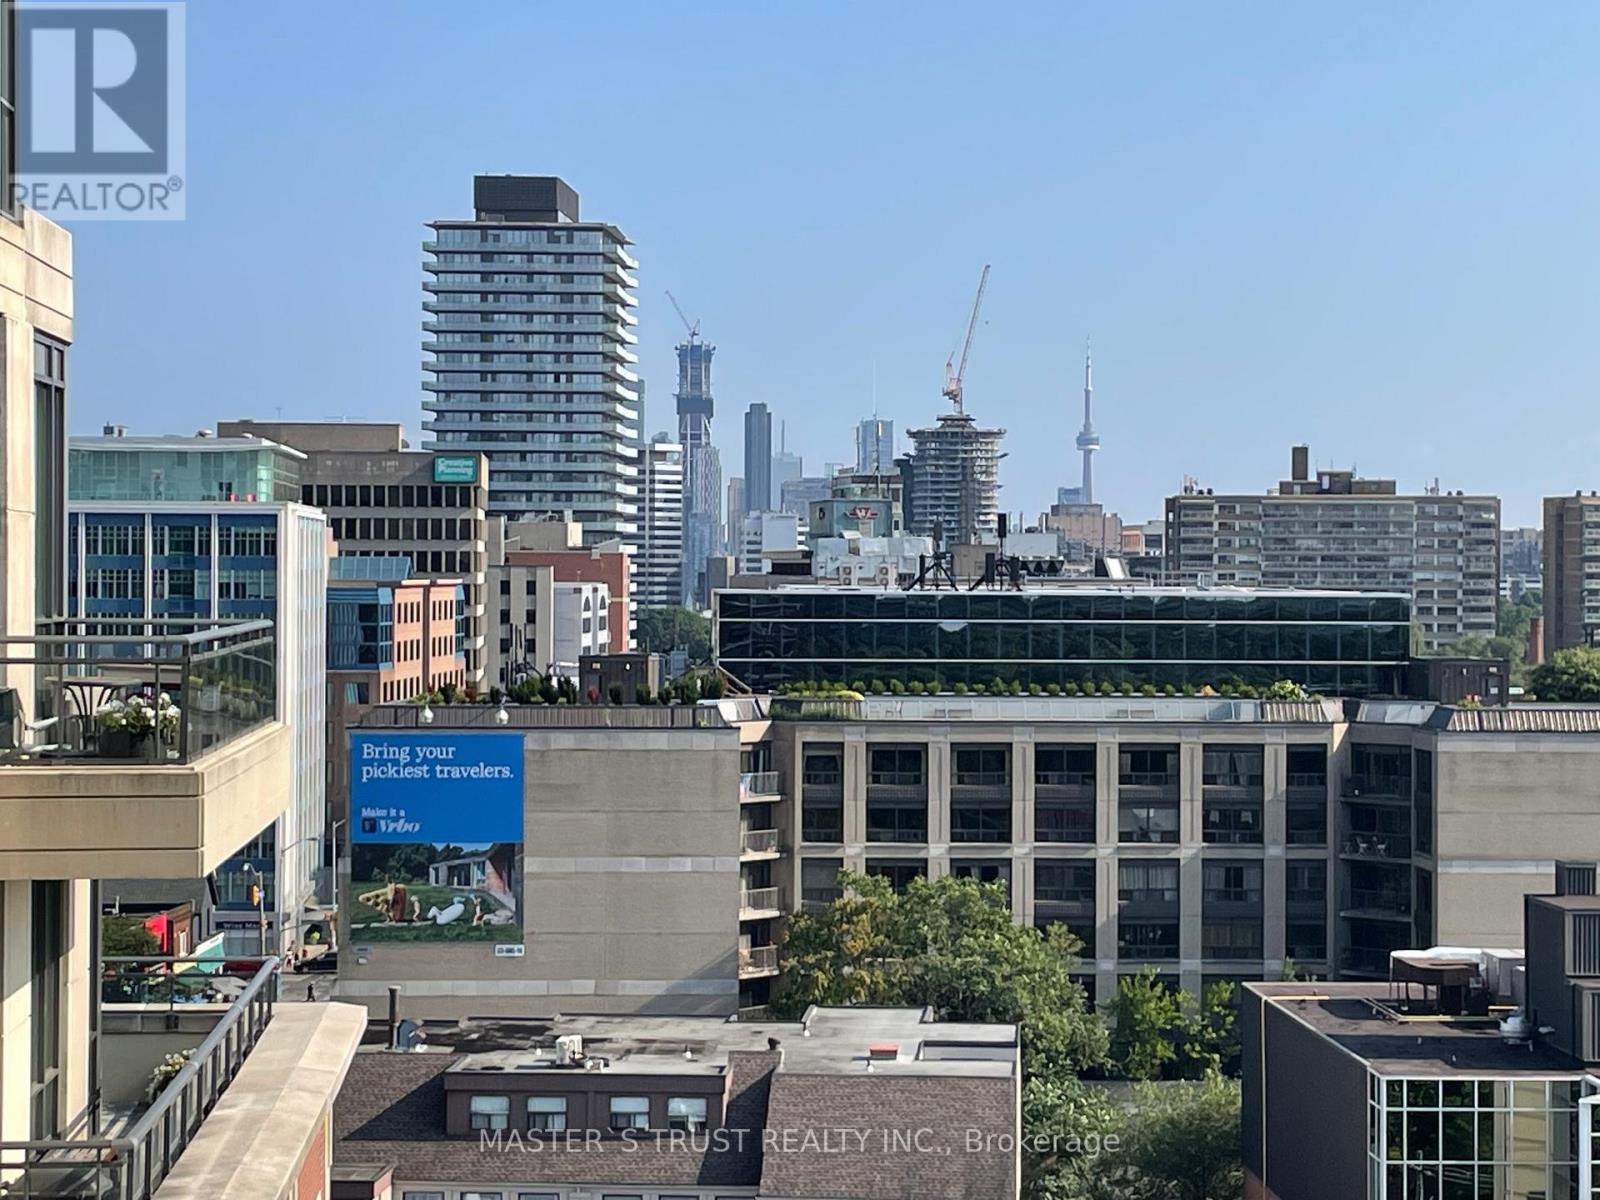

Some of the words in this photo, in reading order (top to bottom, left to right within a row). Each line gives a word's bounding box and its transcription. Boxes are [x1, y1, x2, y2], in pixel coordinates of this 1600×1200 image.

[361, 743, 410, 763] Bring
[415, 746, 456, 763] your
[361, 762, 430, 782] pickiest
[435, 762, 514, 779] travelers.
[361, 807, 388, 817] Make
[399, 809, 406, 817] a
[379, 818, 421, 833] Vrbo
